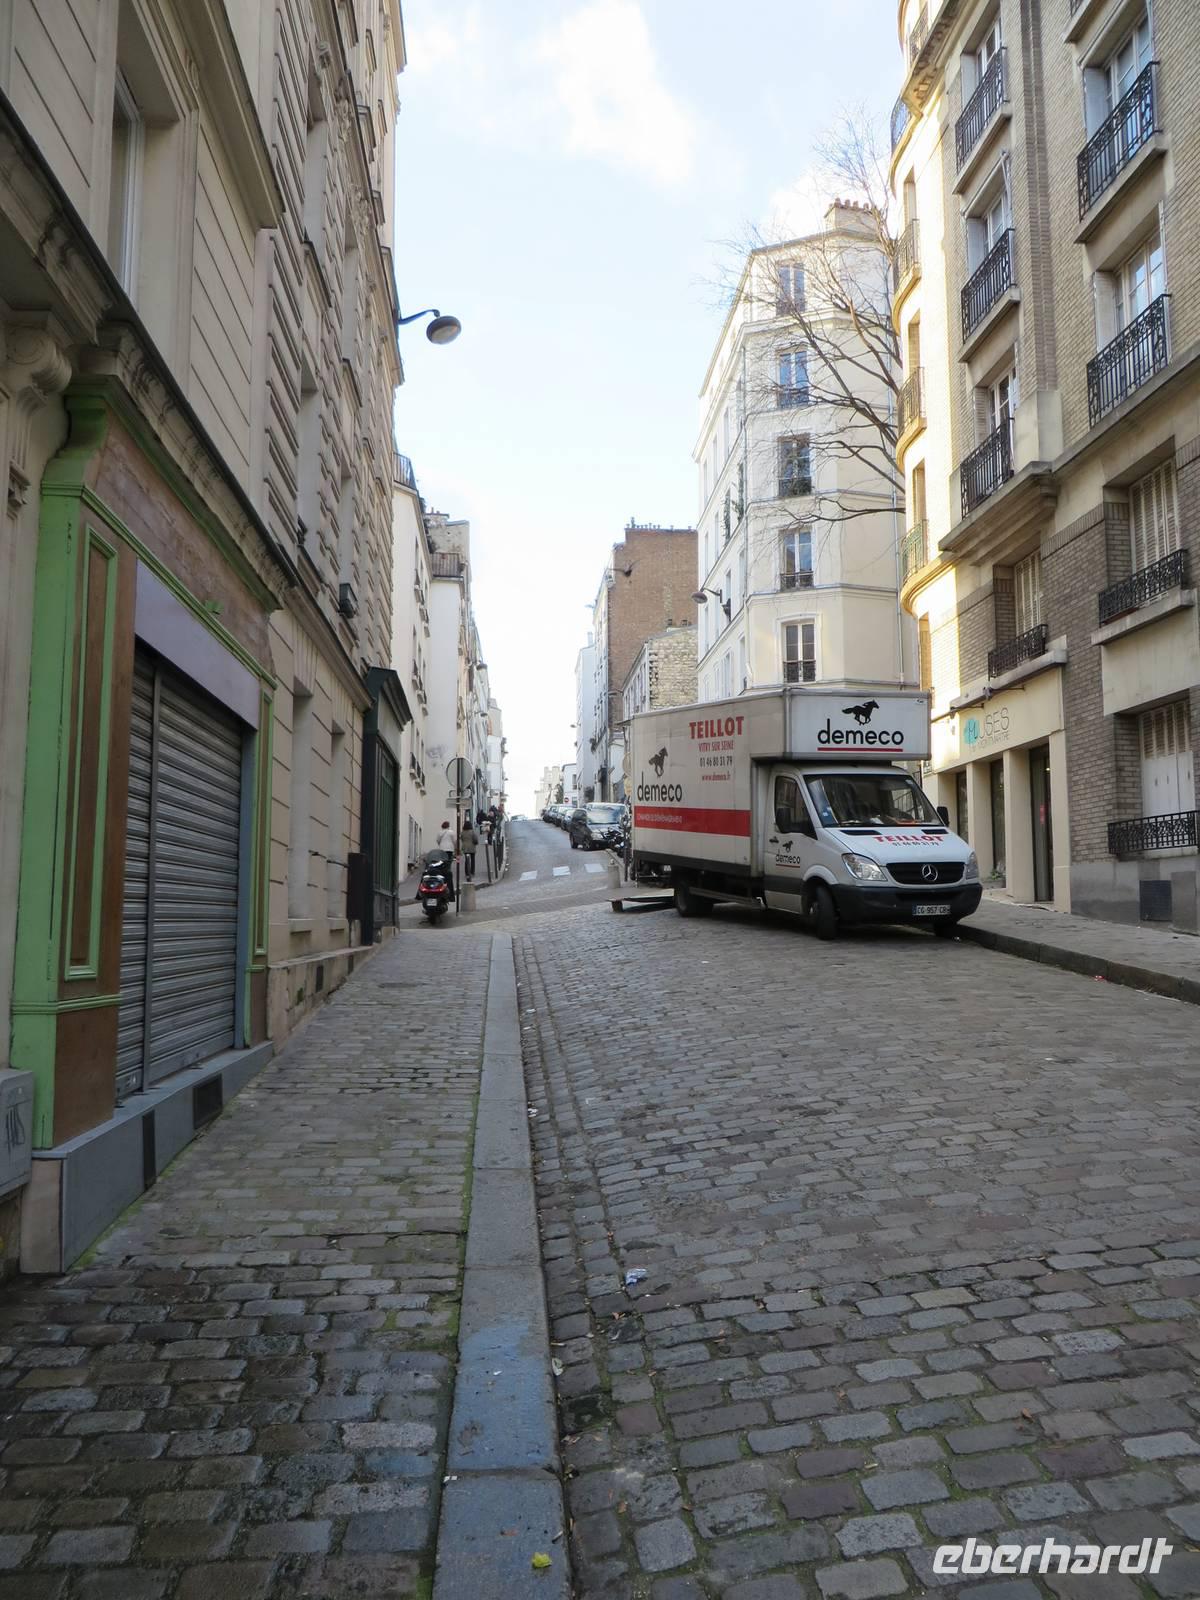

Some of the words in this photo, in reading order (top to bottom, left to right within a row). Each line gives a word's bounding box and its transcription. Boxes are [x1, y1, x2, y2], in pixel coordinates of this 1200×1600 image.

[688, 715, 745, 740] TEILLOT
[817, 717, 905, 746] demeco
[967, 707, 1010, 745] MUSES
[636, 771, 683, 802] demeco
[872, 835, 944, 843] TEILLOT
[775, 849, 801, 864] demeco
